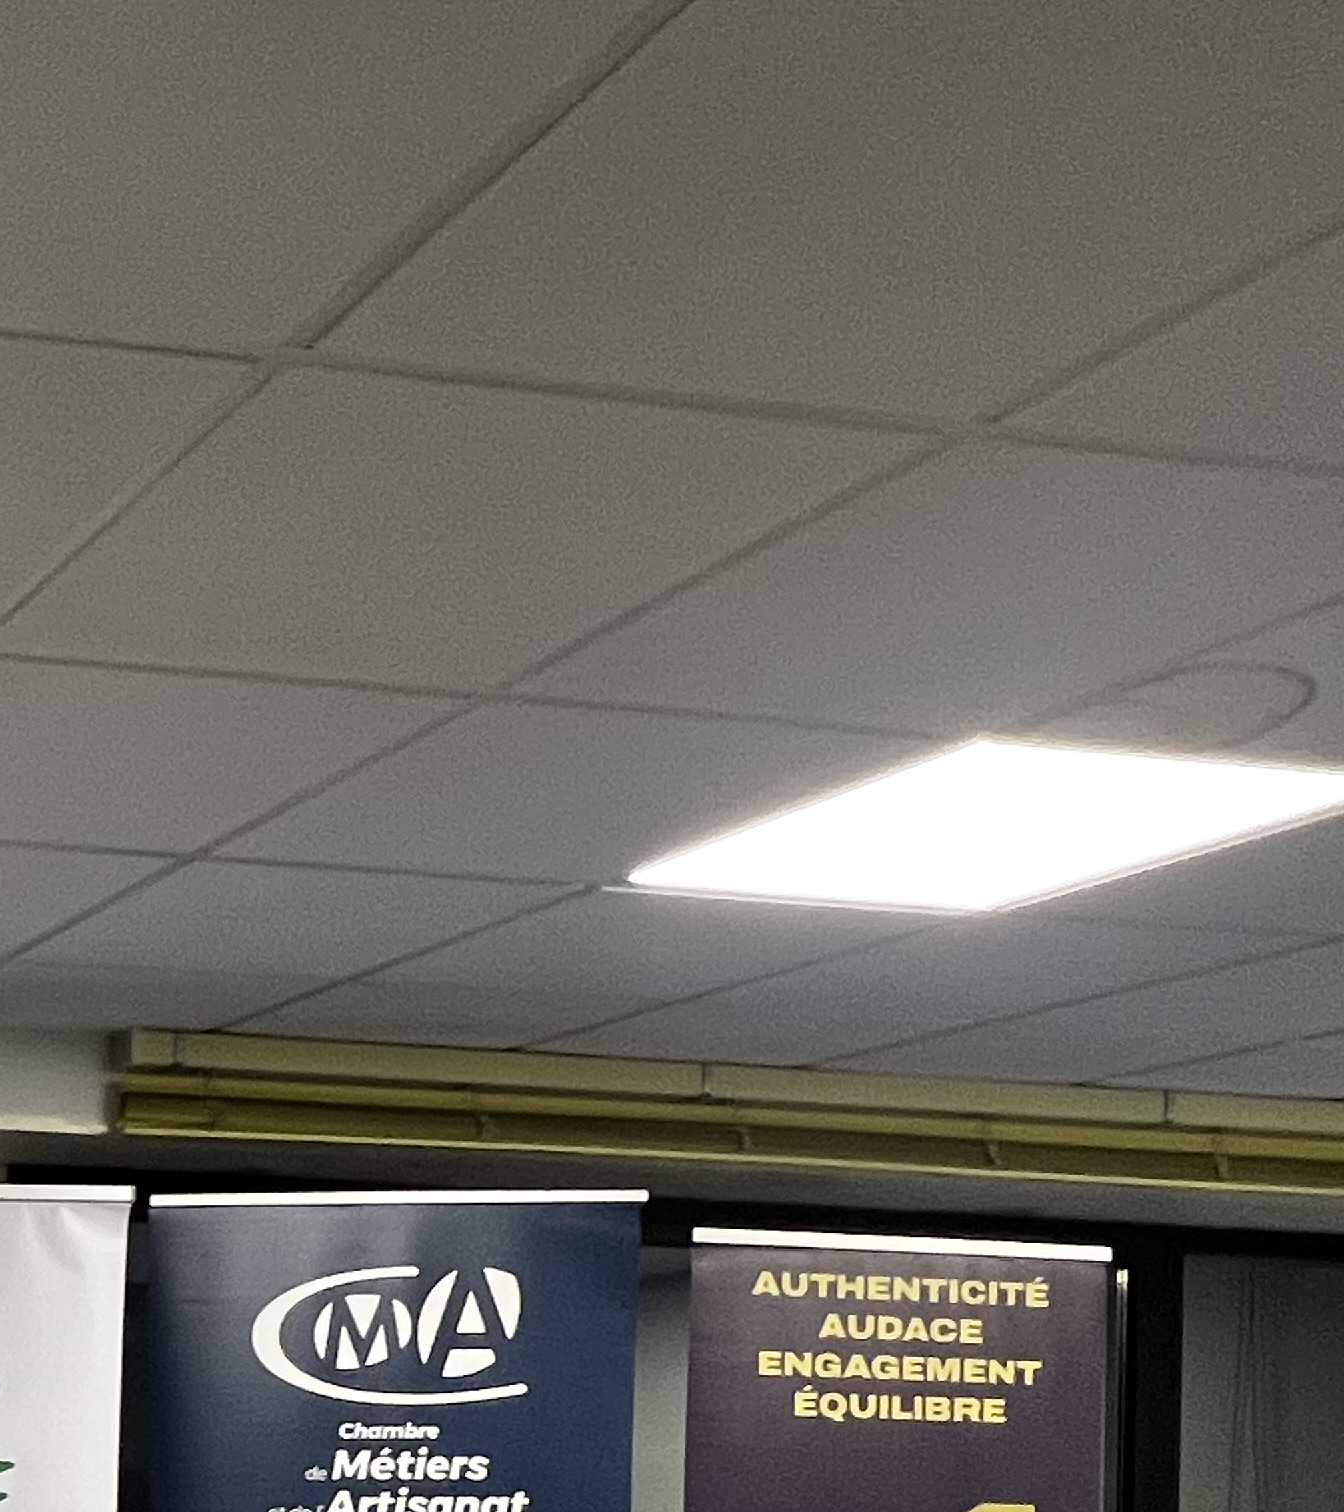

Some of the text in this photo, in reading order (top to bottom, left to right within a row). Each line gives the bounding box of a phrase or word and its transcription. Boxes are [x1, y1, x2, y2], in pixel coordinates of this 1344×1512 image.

[752, 1270, 1050, 1308] AUTHENTICITÉ
[818, 1313, 984, 1344] AUDACE
[758, 1350, 1043, 1386] ENGAGEMENT
[794, 1384, 1008, 1424] ÉQUILIBRE
[338, 1421, 440, 1440] Chambre
[304, 1446, 490, 1481] de Métiers
